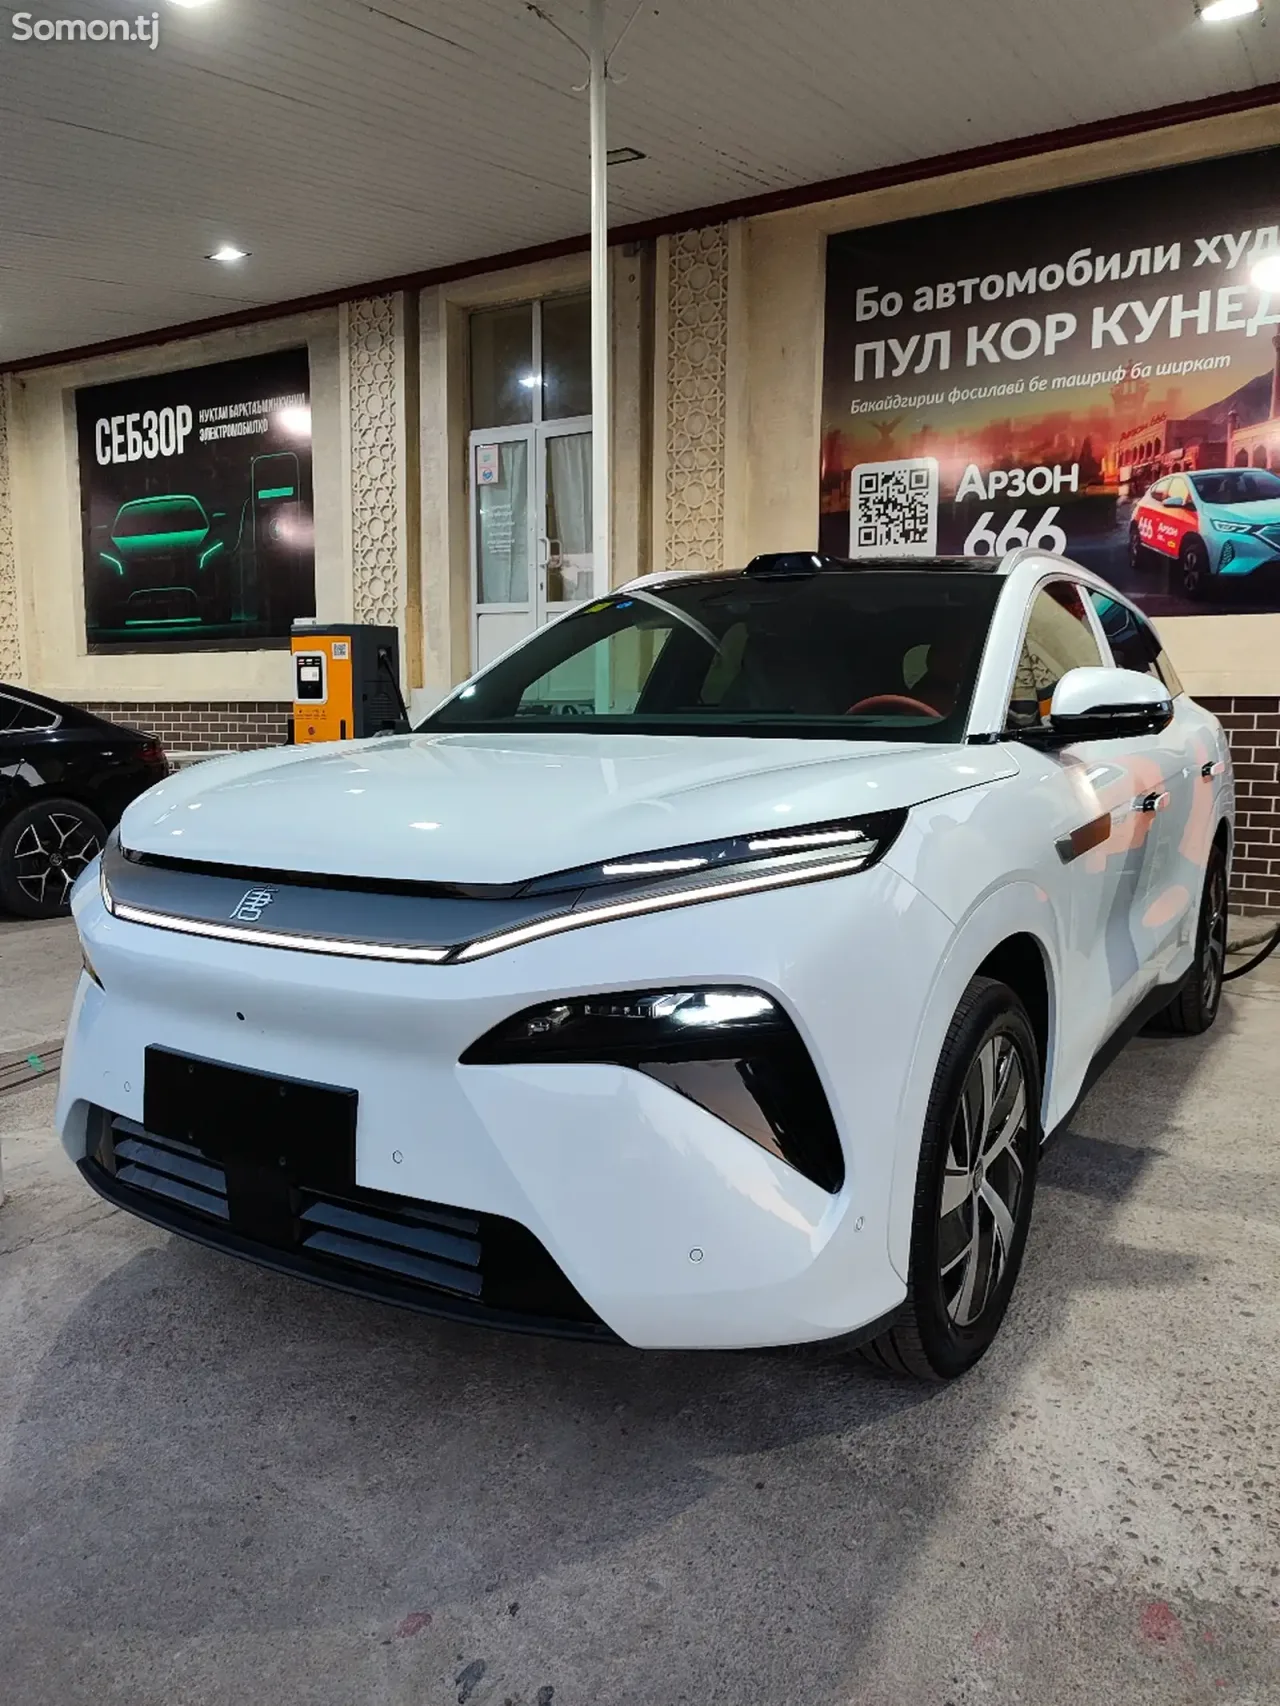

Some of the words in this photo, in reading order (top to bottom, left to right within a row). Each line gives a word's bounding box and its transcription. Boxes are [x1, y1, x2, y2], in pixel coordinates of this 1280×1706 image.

[855, 285, 904, 322] Бо
[912, 241, 1182, 313] автомобили
[854, 330, 951, 382] ПУЛ
[965, 312, 1077, 367] КОР
[1028, 375, 1048, 393] бе
[1051, 364, 1127, 390] ташриф
[1130, 361, 1151, 379] ба
[1155, 354, 1231, 376] ширкат
[95, 404, 193, 466] СЕБЗОР
[963, 506, 1067, 557] 666
